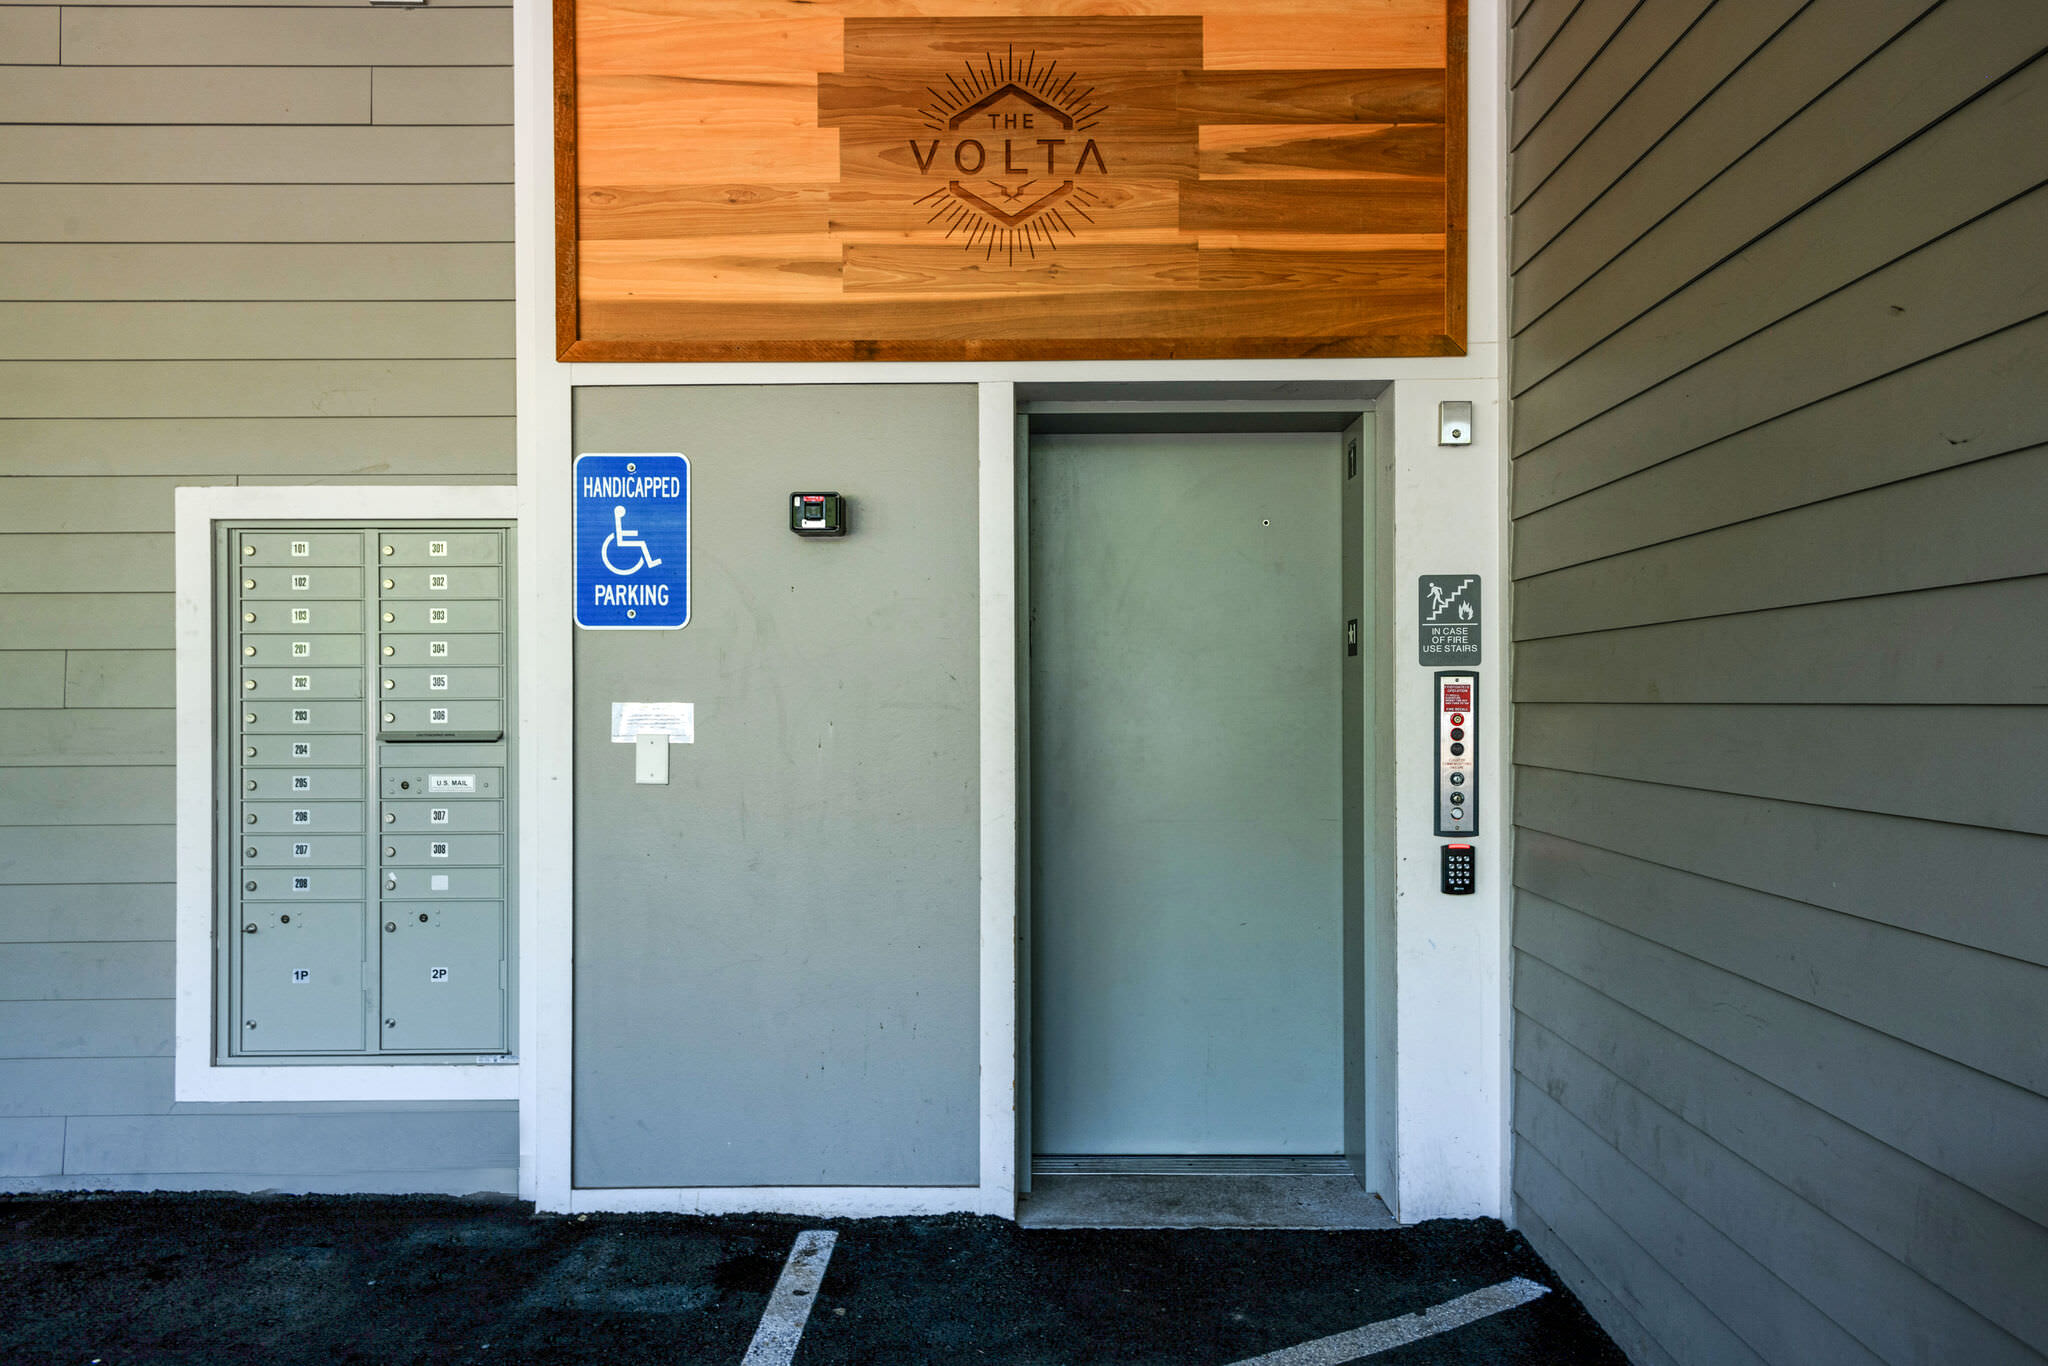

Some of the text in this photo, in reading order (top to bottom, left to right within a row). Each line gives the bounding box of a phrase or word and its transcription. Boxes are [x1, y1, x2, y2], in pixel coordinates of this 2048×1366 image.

[987, 113, 1034, 129] THE
[909, 138, 1108, 175] VOLTA
[583, 476, 680, 498] HANDICAPPED
[294, 544, 306, 553] 101
[432, 543, 444, 552] 301
[294, 577, 306, 587] 102
[432, 577, 444, 586] 302
[594, 584, 669, 606] PARKING
[432, 610, 445, 620] 303
[1431, 627, 1469, 635] IN CASE
[1431, 635, 1469, 644] OF FIRE
[432, 644, 445, 653] 304
[1422, 644, 1478, 653] USE STAIRS
[433, 811, 446, 820] 307
[295, 845, 308, 854] 207
[294, 971, 308, 980] 1P
[432, 969, 447, 979] 2P
